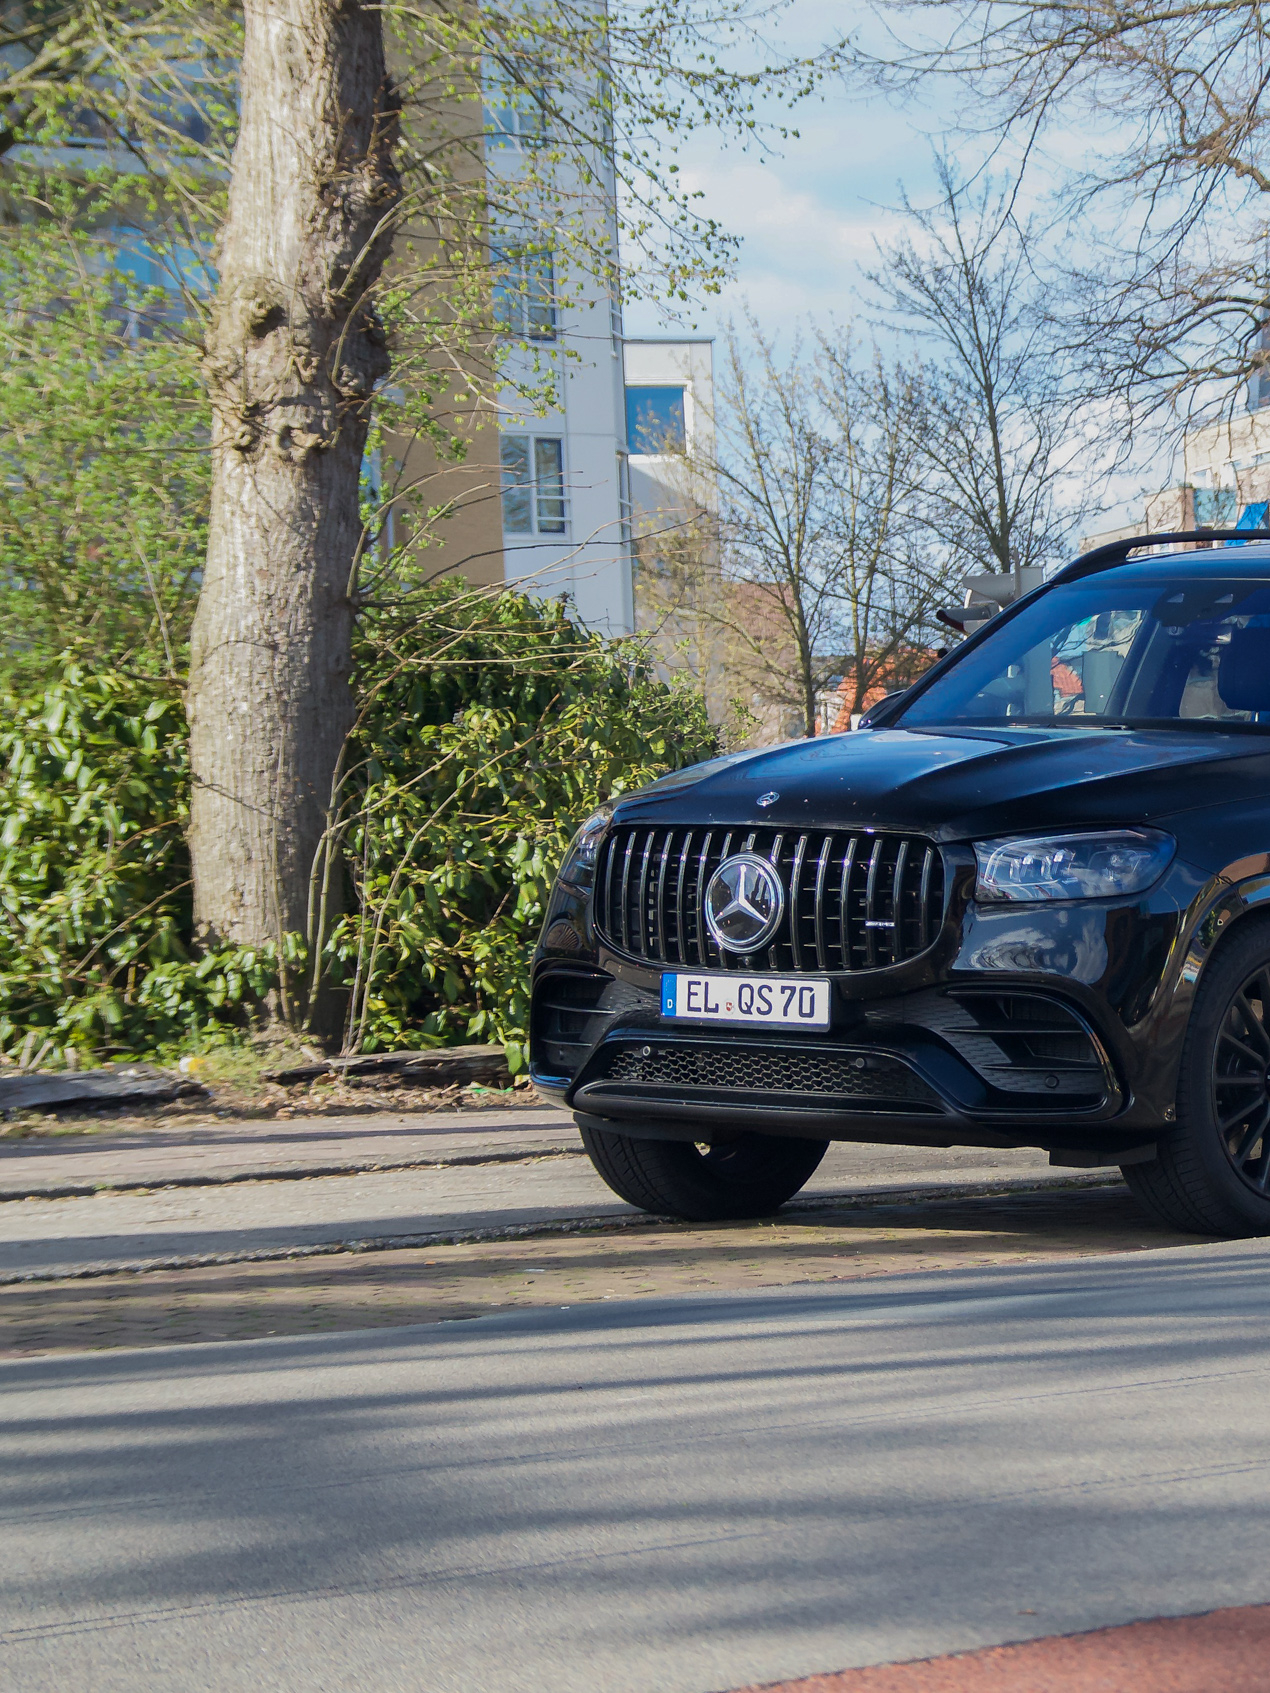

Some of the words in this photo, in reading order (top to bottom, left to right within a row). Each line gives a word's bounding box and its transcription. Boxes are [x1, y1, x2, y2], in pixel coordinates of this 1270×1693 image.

[667, 998, 674, 1009] D
[687, 981, 719, 1014] EL
[738, 983, 773, 1016] QS
[780, 985, 816, 1018] 70
